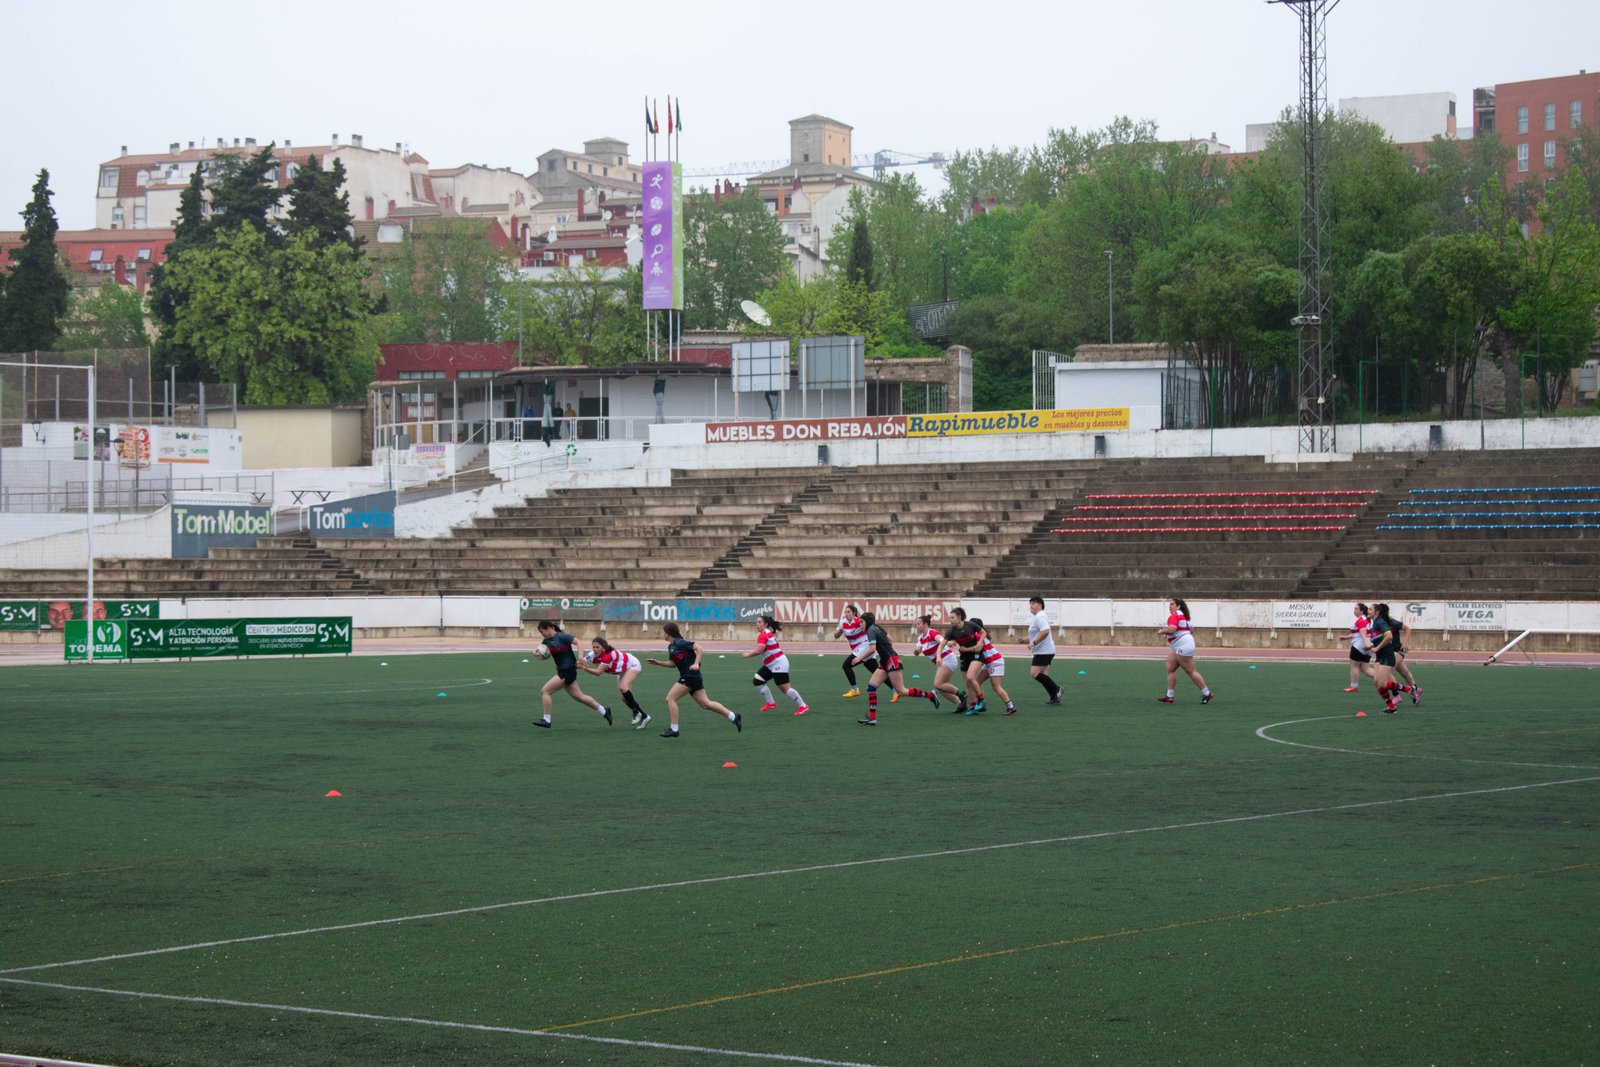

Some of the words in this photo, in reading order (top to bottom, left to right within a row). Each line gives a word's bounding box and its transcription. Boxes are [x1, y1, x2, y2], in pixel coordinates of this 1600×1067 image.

[1066, 410, 1095, 419] mejores
[1096, 409, 1122, 418] precios
[707, 424, 775, 441] MUEBLES
[783, 424, 821, 439] DON
[828, 416, 906, 438] REBAJÓN
[908, 413, 1039, 435] Rapimueble
[1055, 421, 1085, 429] muebles
[1086, 421, 1091, 430] y
[1092, 419, 1127, 428] descanso
[740, 603, 773, 617] Canapés
[875, 604, 942, 621] MUEBLES
[1457, 610, 1494, 618] VEGA
[169, 628, 185, 636] ALTA
[187, 626, 233, 635] TECNOLOGÍA
[248, 626, 276, 634] CENTRO
[277, 625, 304, 633] MÉDICO
[305, 625, 315, 633] SM
[174, 636, 206, 644] ATENCIÓN
[207, 636, 239, 644] PERSONAL
